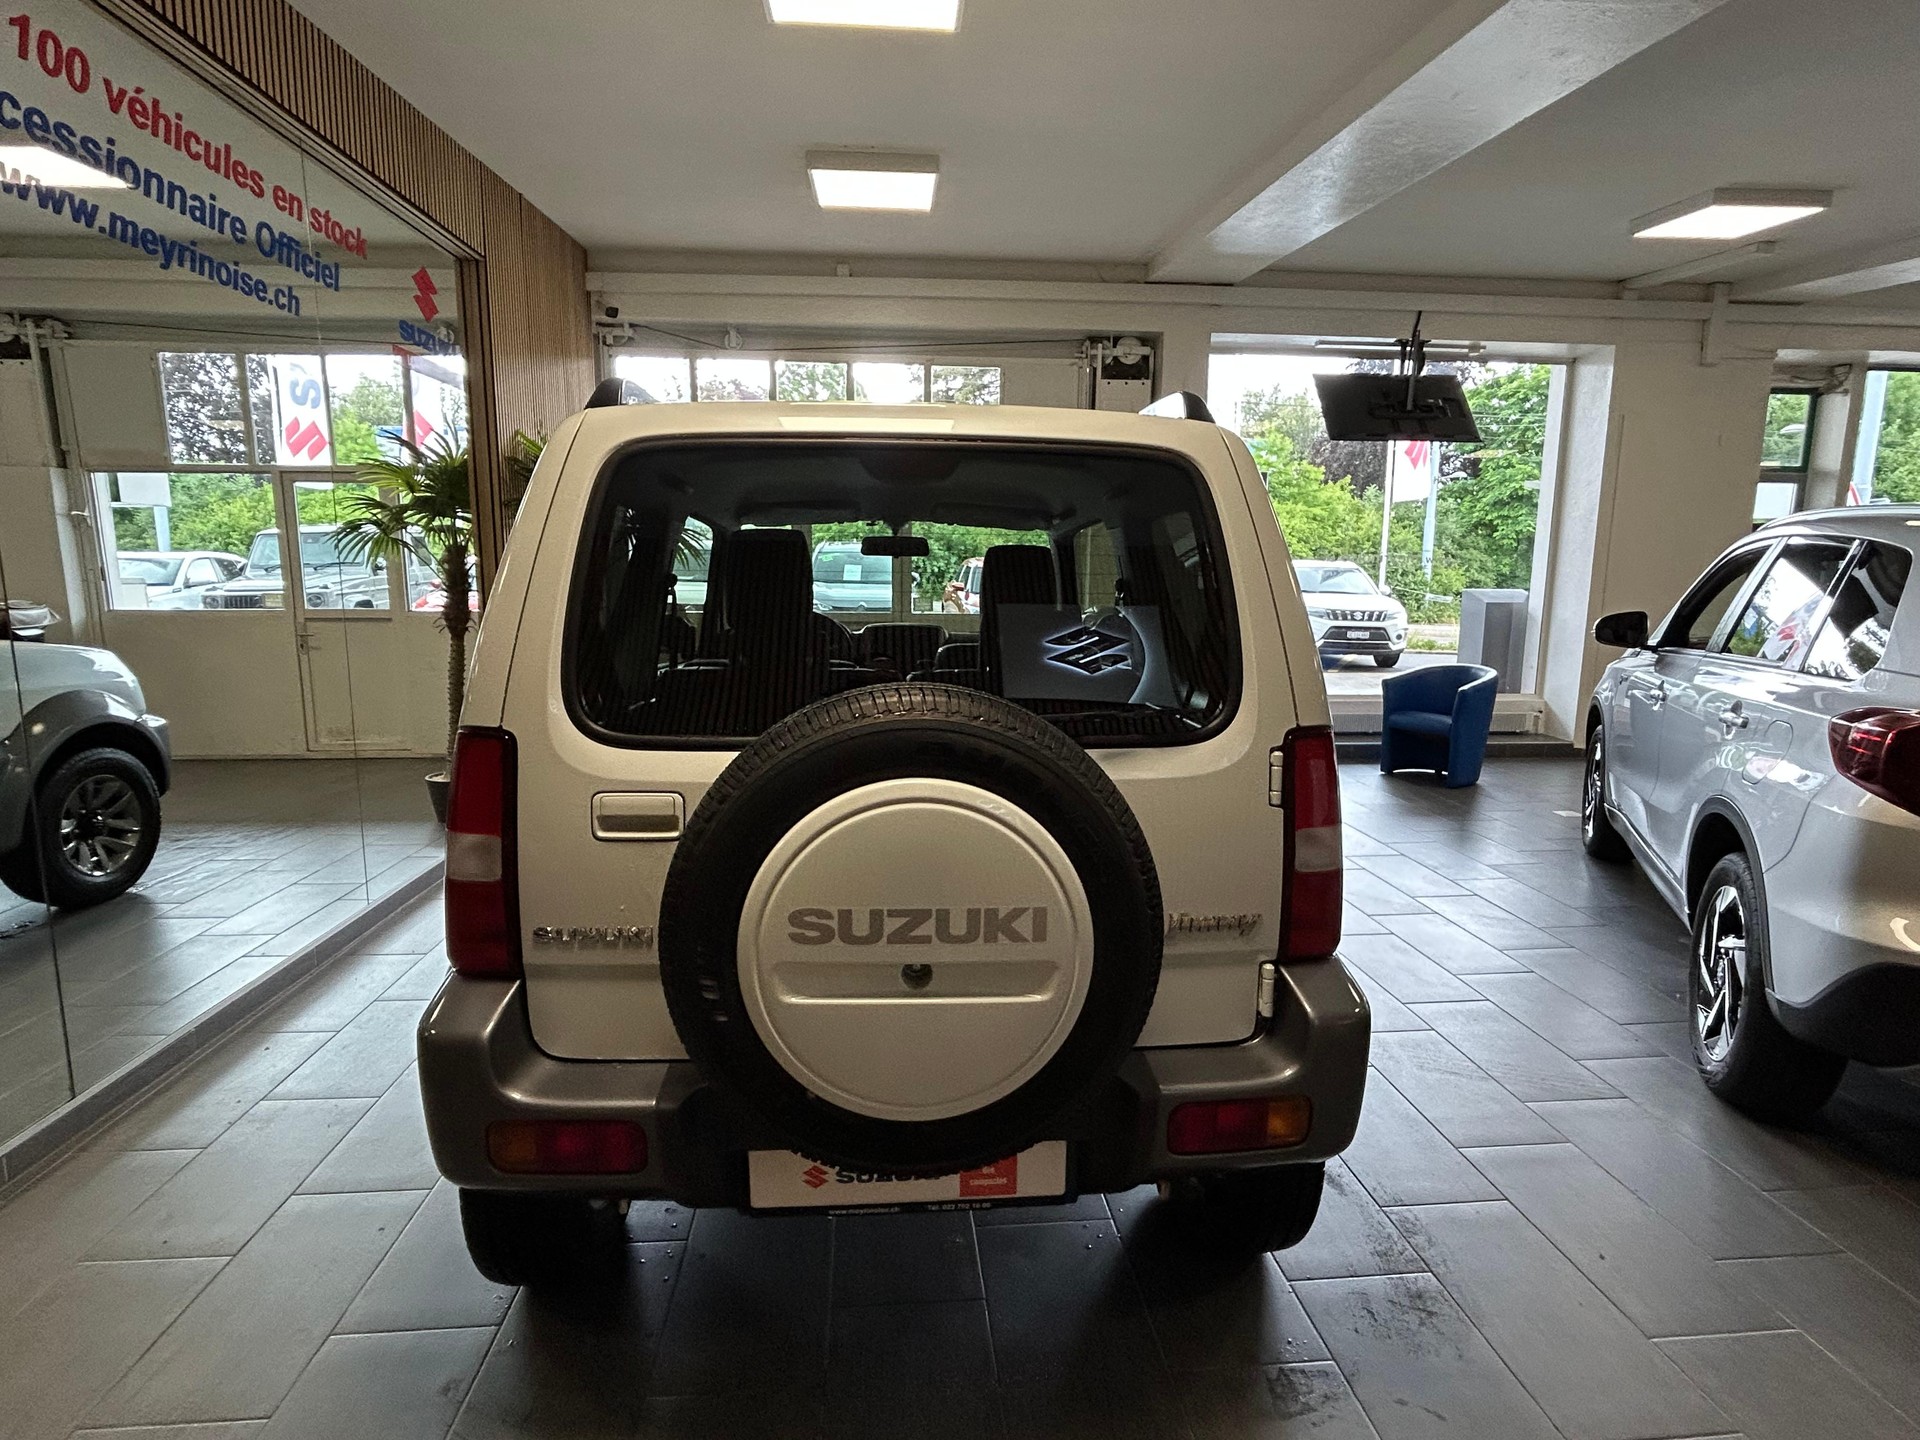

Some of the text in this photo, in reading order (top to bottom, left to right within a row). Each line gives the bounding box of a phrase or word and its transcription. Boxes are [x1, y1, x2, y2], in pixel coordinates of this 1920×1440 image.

[0, 91, 340, 292] cessionnaire Officiel
[8, 14, 368, 260] 100 véhicules en stock
[0, 160, 300, 317] www.meyrinoise.ch
[787, 907, 1048, 945] SUZUKI
